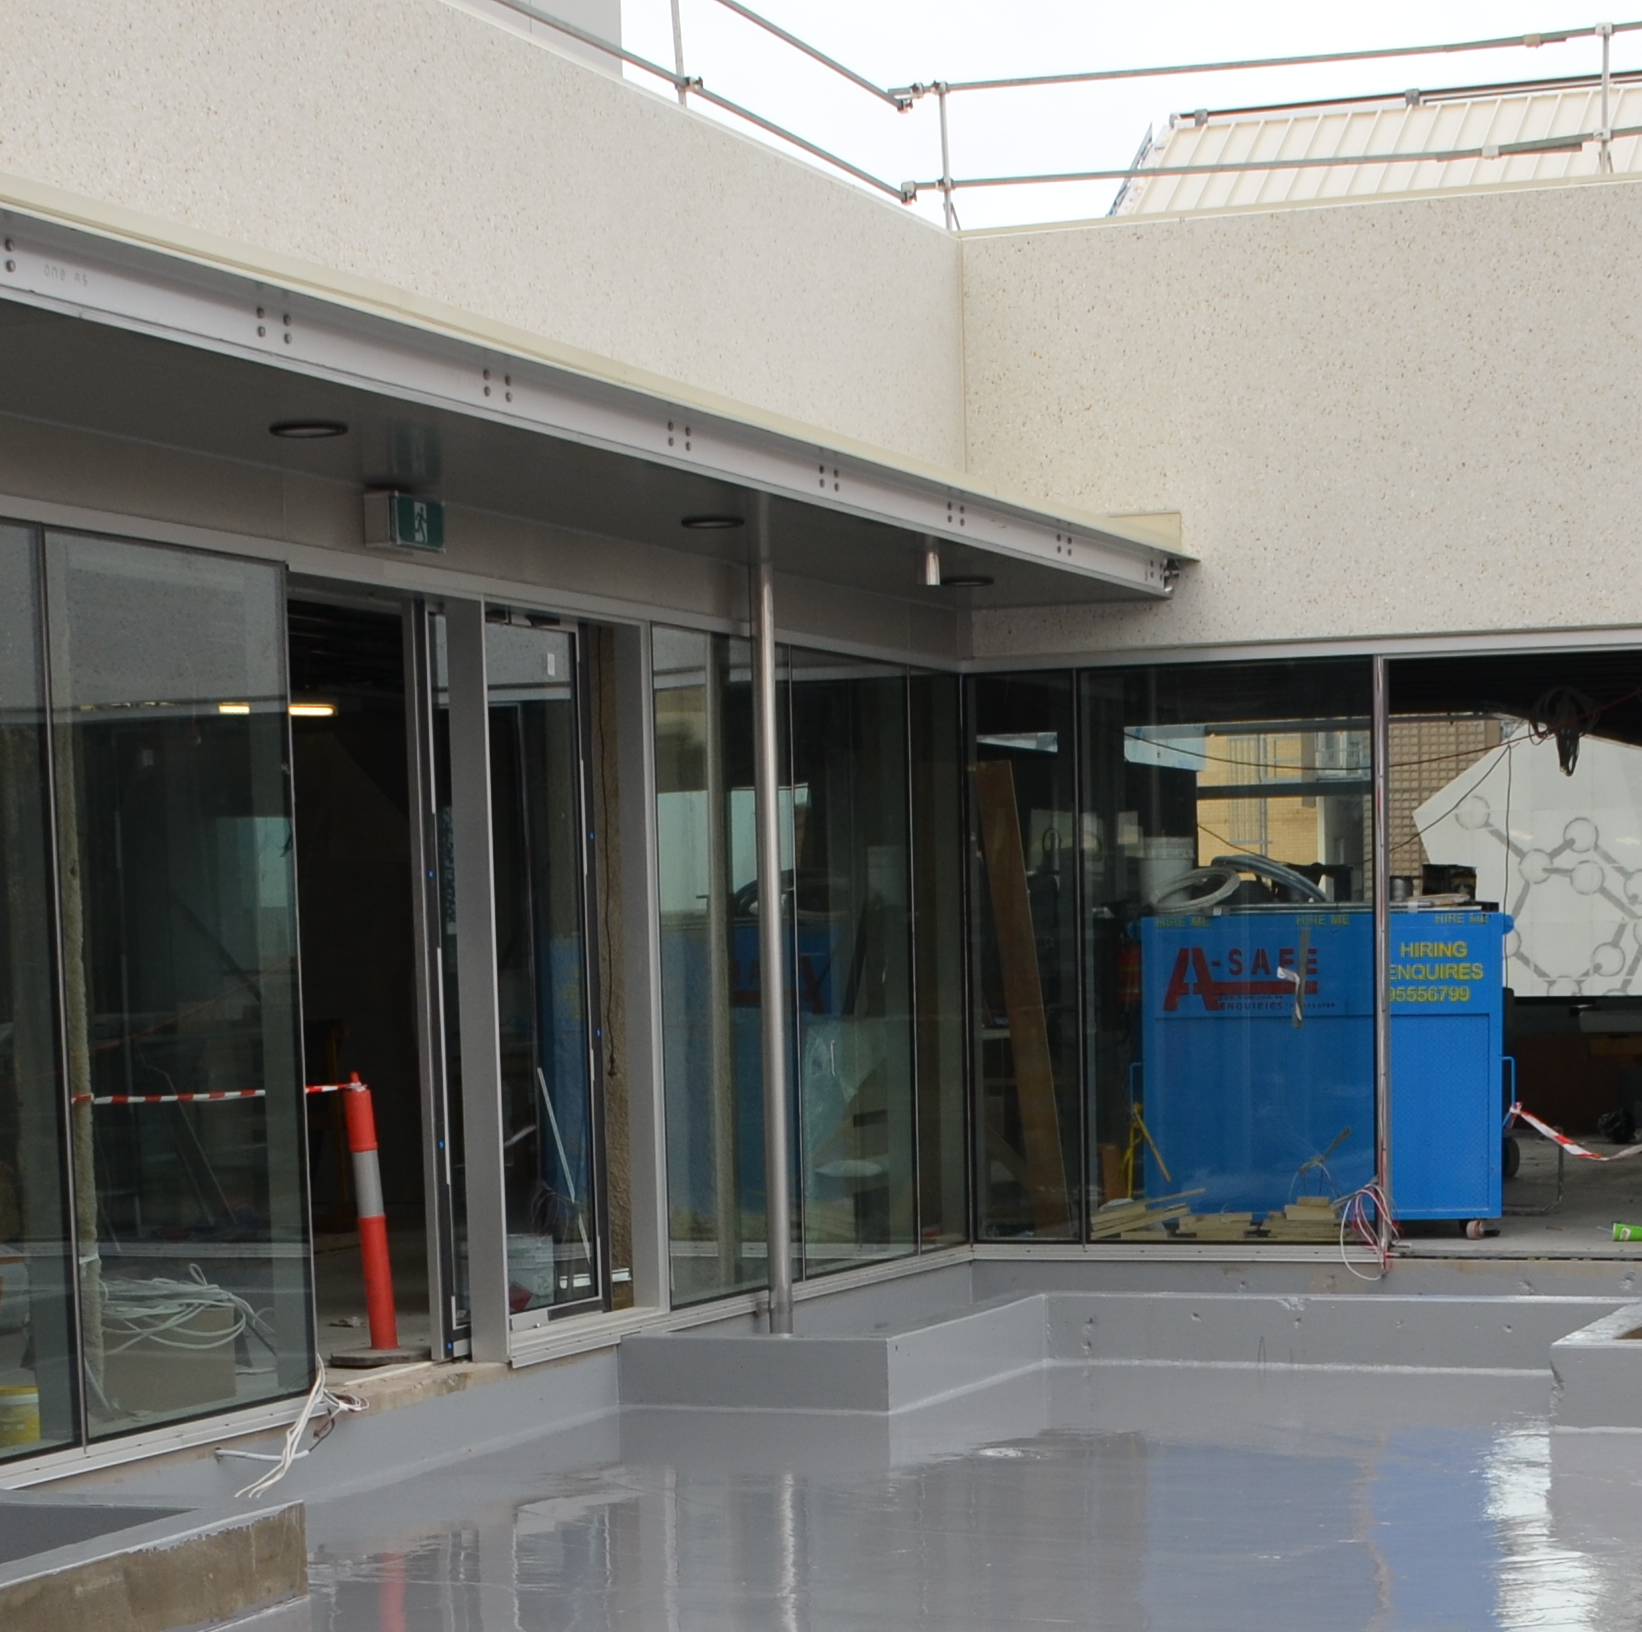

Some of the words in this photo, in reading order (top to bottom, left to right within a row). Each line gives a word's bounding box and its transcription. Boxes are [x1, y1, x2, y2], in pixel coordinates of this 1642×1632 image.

[1156, 916, 1186, 928] HIRE
[1296, 914, 1326, 926] HIRE
[1331, 914, 1349, 926] ME
[1434, 912, 1465, 924] HIRE
[1400, 941, 1468, 958] HIRING
[1163, 946, 1318, 1011] A-SAFE
[1389, 963, 1484, 981] ENQUIRES
